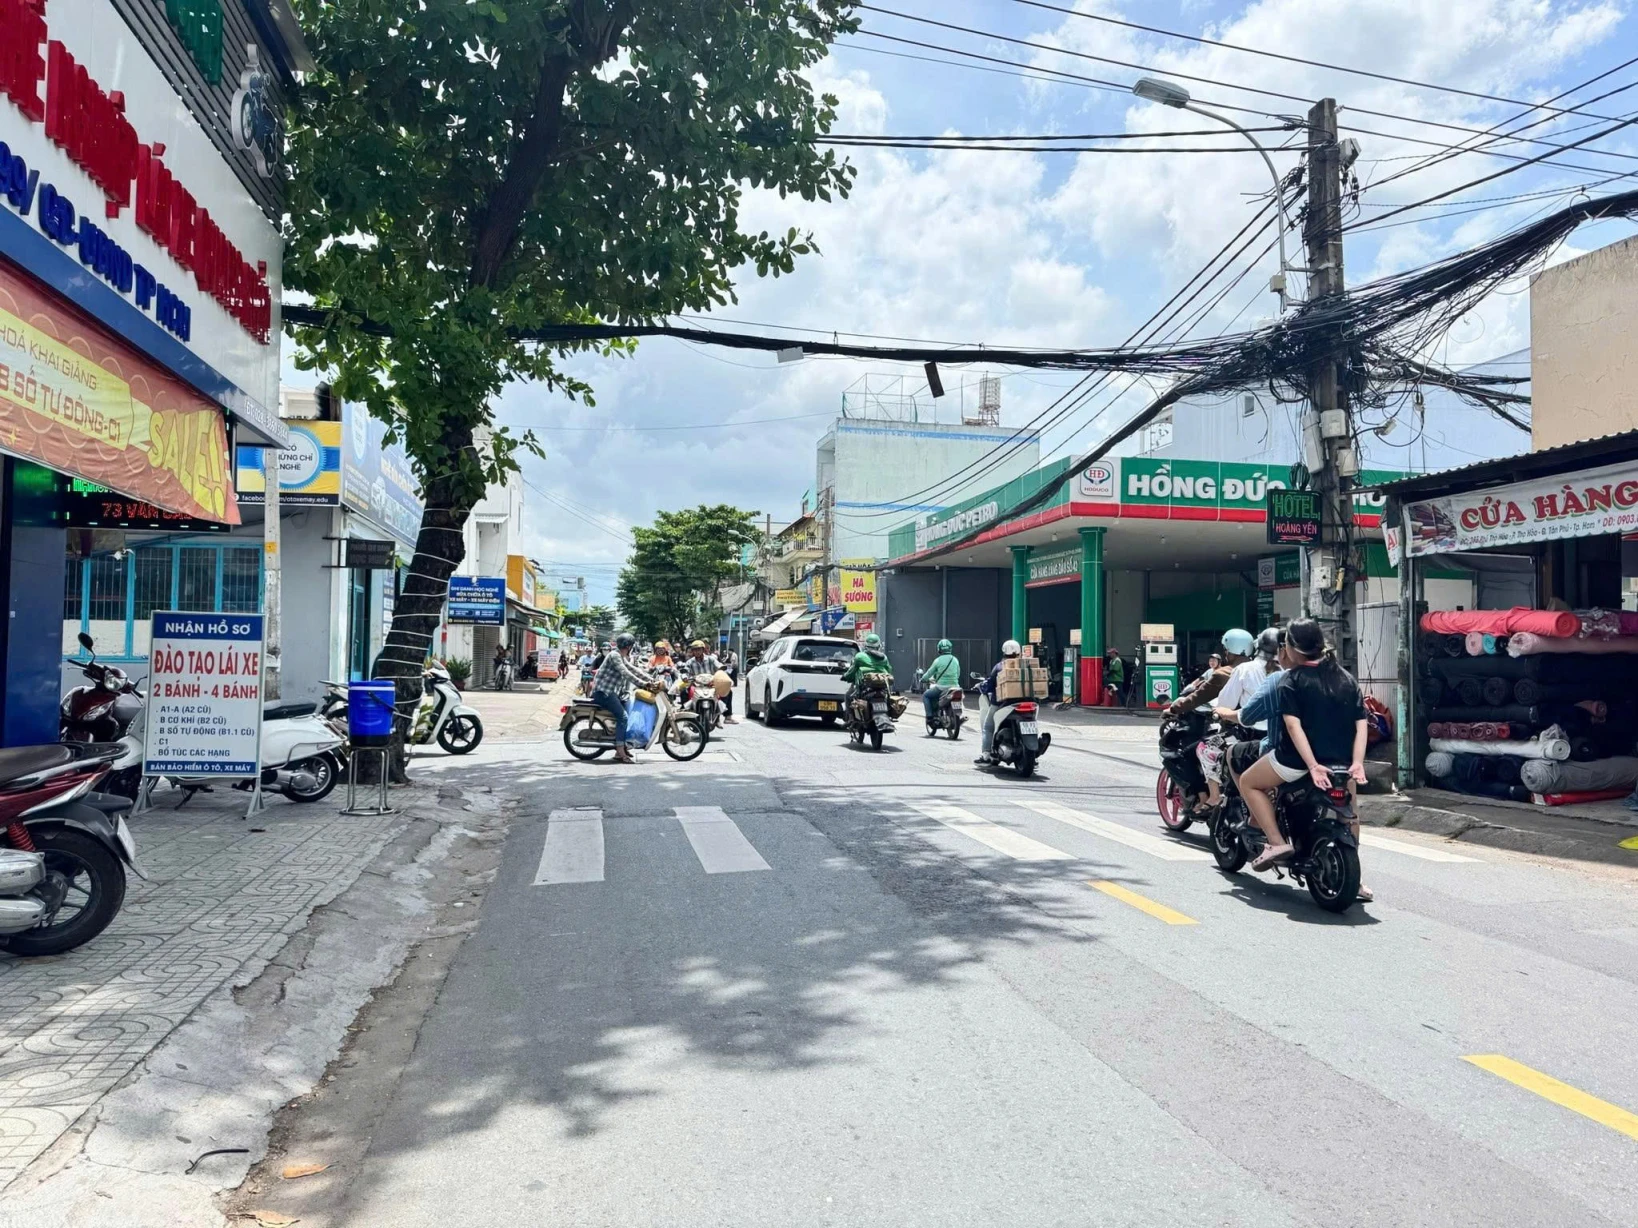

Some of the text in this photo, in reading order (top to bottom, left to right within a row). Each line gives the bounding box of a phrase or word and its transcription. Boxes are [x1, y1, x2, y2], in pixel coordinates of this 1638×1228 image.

[30, 340, 59, 371] KHAI
[62, 359, 97, 391] GIẢNG
[14, 365, 37, 404] SỐ
[41, 383, 62, 423] TỰ
[148, 409, 226, 520] SALE!
[300, 453, 313, 461] CHỈ
[1128, 464, 1217, 499] HỒNG
[101, 503, 122, 518] 73
[966, 501, 998, 528] PETRO
[1274, 494, 1318, 519] HOTEL
[1461, 481, 1638, 531] CỬA HÀNG
[1276, 521, 1317, 534] HOÀNG YẾN
[165, 619, 251, 636] NHẬN HỒ SƠ
[154, 643, 258, 681] ĐÀO TẠO LÁI XE
[153, 683, 161, 697] 2
[165, 680, 200, 698] BÁNH
[211, 684, 219, 698] 4
[223, 681, 258, 699] BÁNH
[182, 706, 195, 714] (A2
[181, 716, 195, 724] KHÍ
[197, 717, 210, 725] (B2
[159, 727, 165, 735] B
[218, 728, 238, 737] (B1.1
[172, 746, 187, 756] TÚC
[189, 747, 205, 757] CÁC
[208, 749, 230, 758] HẠNG
[204, 763, 209, 771] Ô
[235, 763, 251, 771] MÁY
